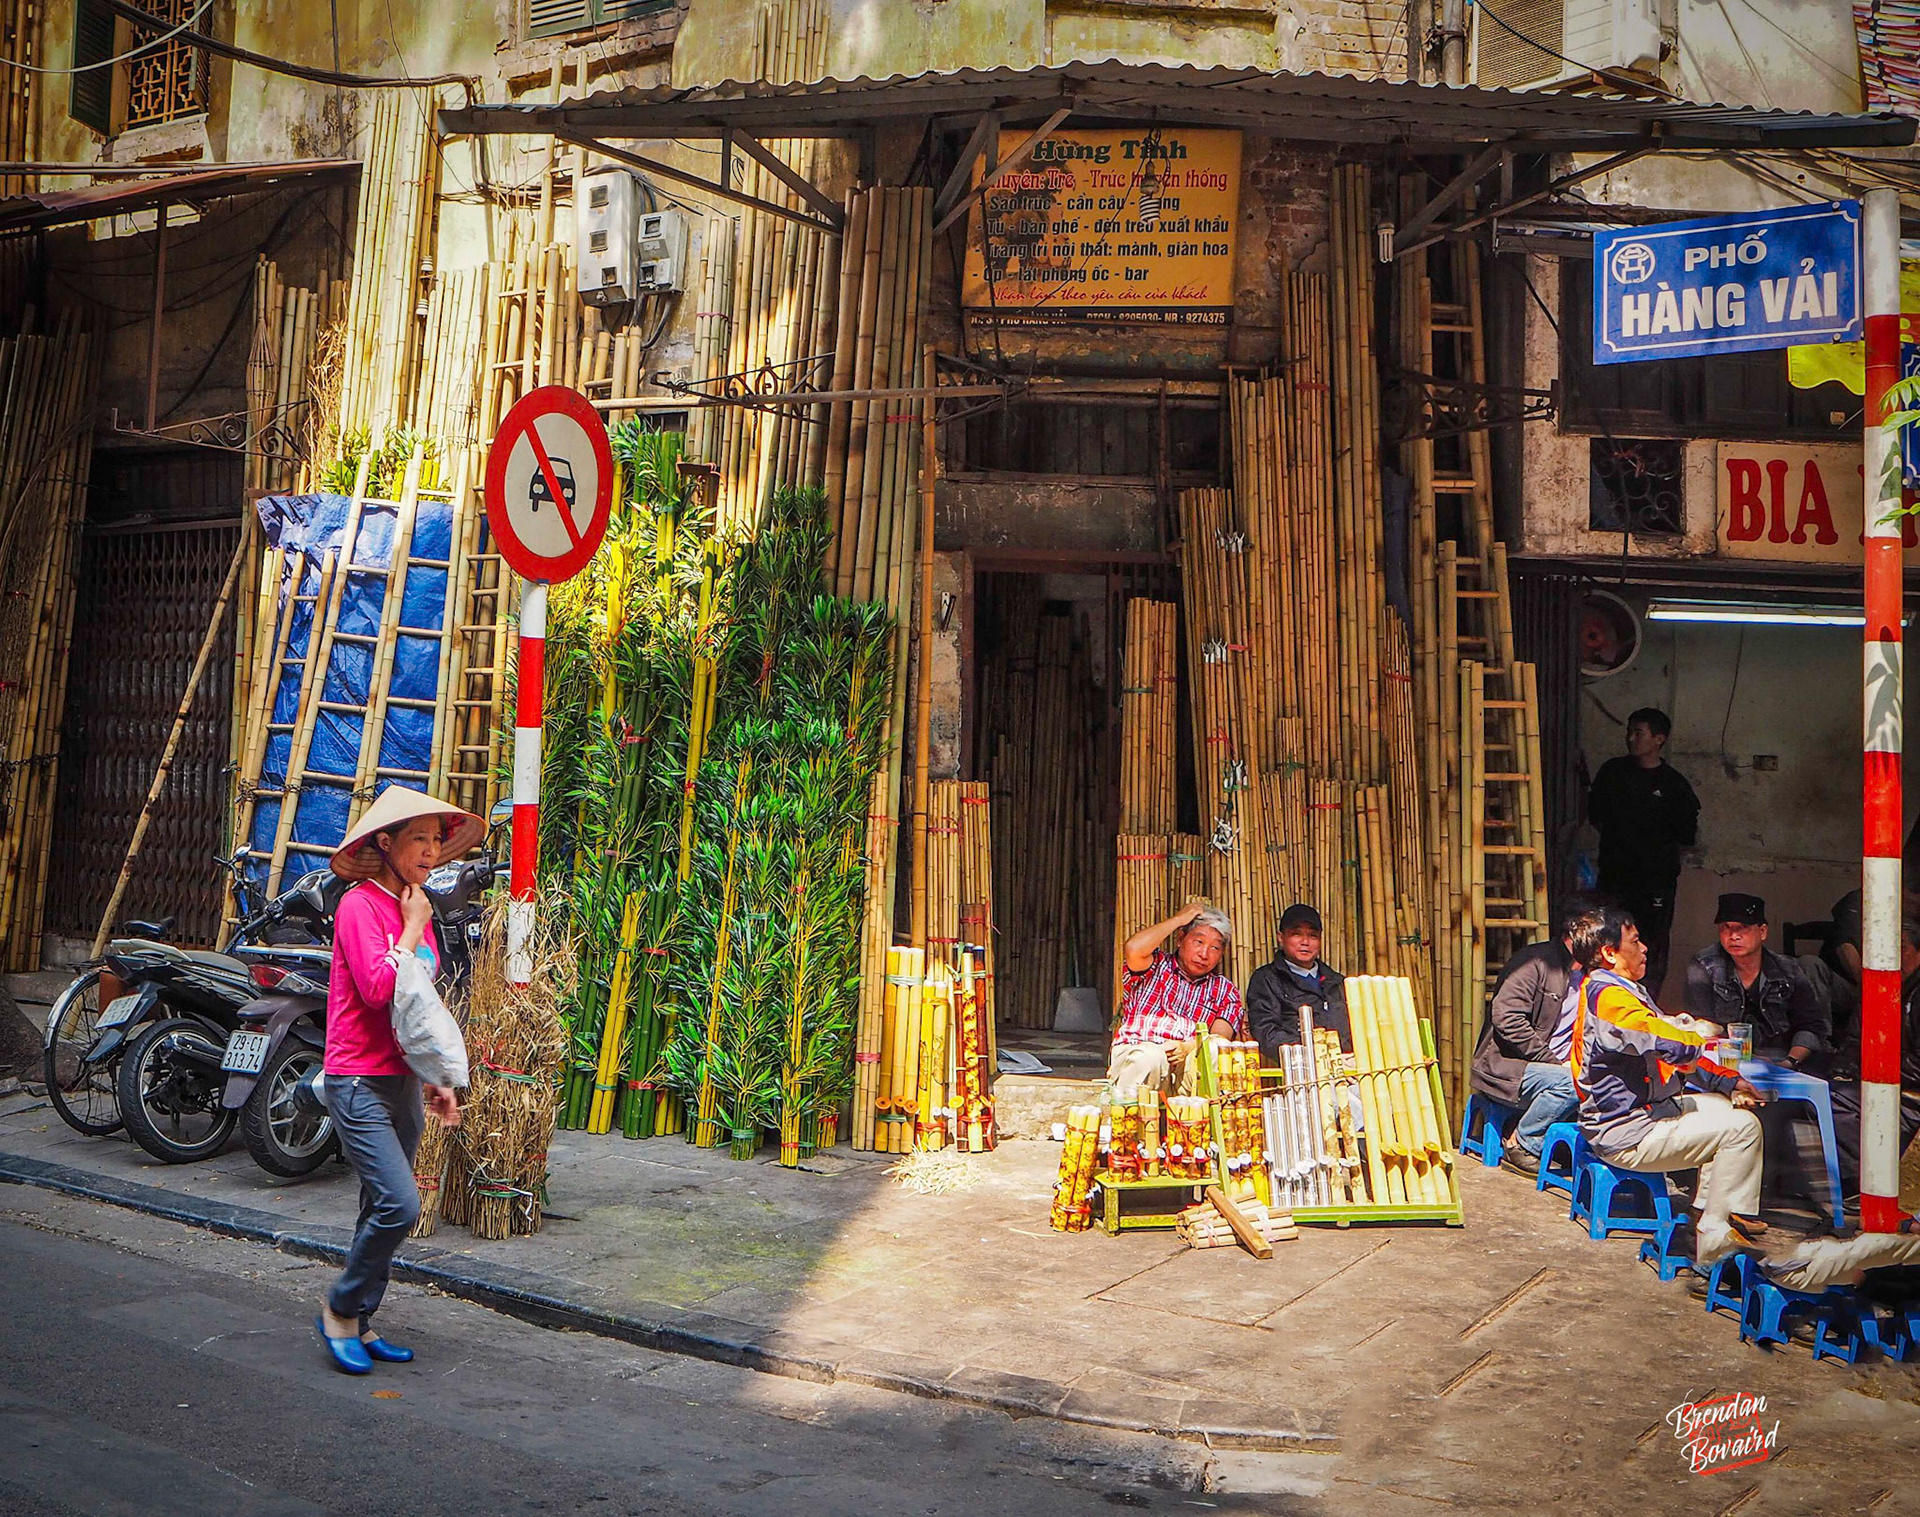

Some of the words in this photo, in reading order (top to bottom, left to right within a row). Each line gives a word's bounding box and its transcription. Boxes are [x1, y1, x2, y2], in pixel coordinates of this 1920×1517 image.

[1031, 138, 1111, 164] Hùng
[1185, 167, 1228, 191] thống
[1067, 192, 1093, 210] cần
[1098, 194, 1125, 210] câu
[1052, 215, 1079, 235] ghế
[1094, 217, 1121, 233] đèn
[1125, 219, 1154, 233] treo
[1158, 214, 1190, 233] xuất
[1194, 214, 1229, 233] khẩu
[1052, 237, 1075, 260] nội
[1202, 241, 1229, 256] hoa
[1684, 229, 1768, 272] PHỐ
[1091, 264, 1110, 281] ốc
[1124, 266, 1150, 281] bar
[1060, 285, 1087, 300] theo
[1091, 288, 1115, 305] yêu
[1118, 285, 1141, 300] cầu
[1171, 285, 1208, 300] khách
[1621, 282, 1745, 338] HÀNG
[1760, 257, 1838, 323] VẢI
[1185, 312, 1226, 324] 9274375
[1725, 458, 1839, 546] BIA
[233, 1034, 263, 1052] 29-C1
[224, 1051, 261, 1070] 313.74
